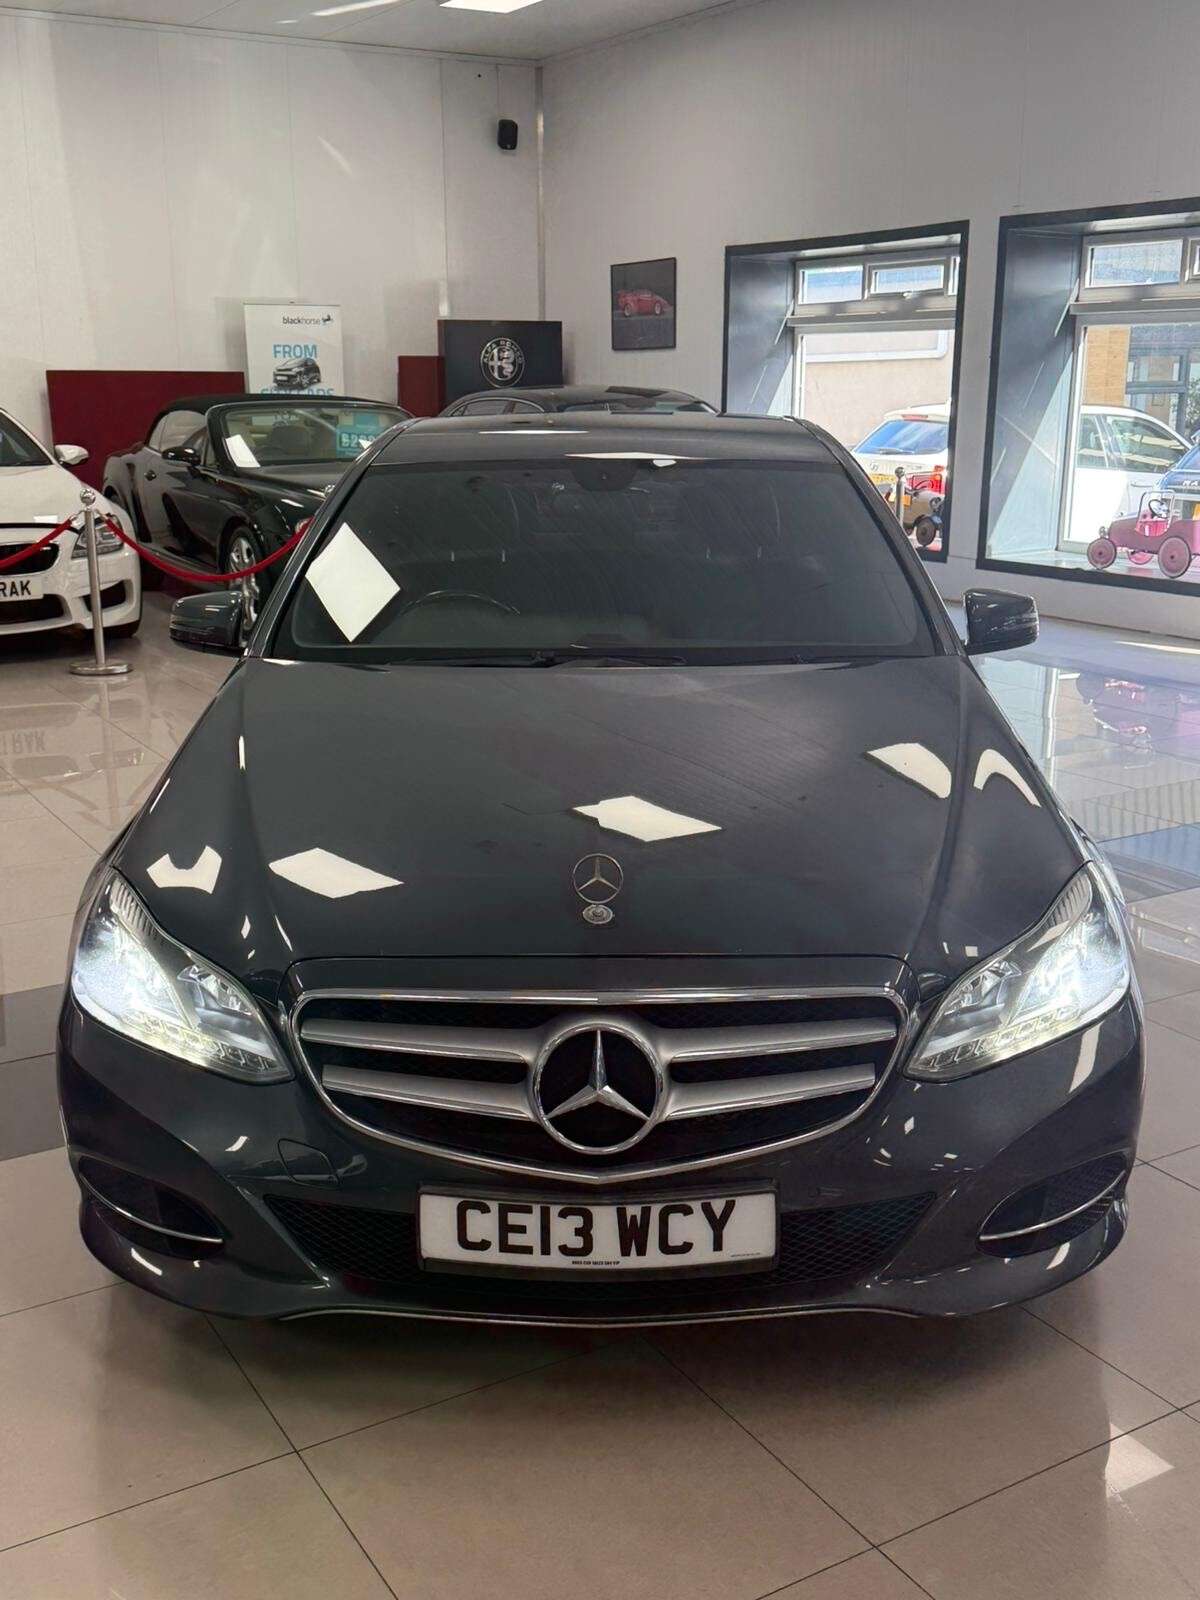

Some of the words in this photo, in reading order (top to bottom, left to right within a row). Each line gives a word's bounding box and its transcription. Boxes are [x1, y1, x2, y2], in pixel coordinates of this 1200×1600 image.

[282, 316, 321, 325] blackhorse
[272, 344, 317, 358] FROM
[456, 1199, 594, 1257] CE13
[616, 1199, 736, 1257] WCY
